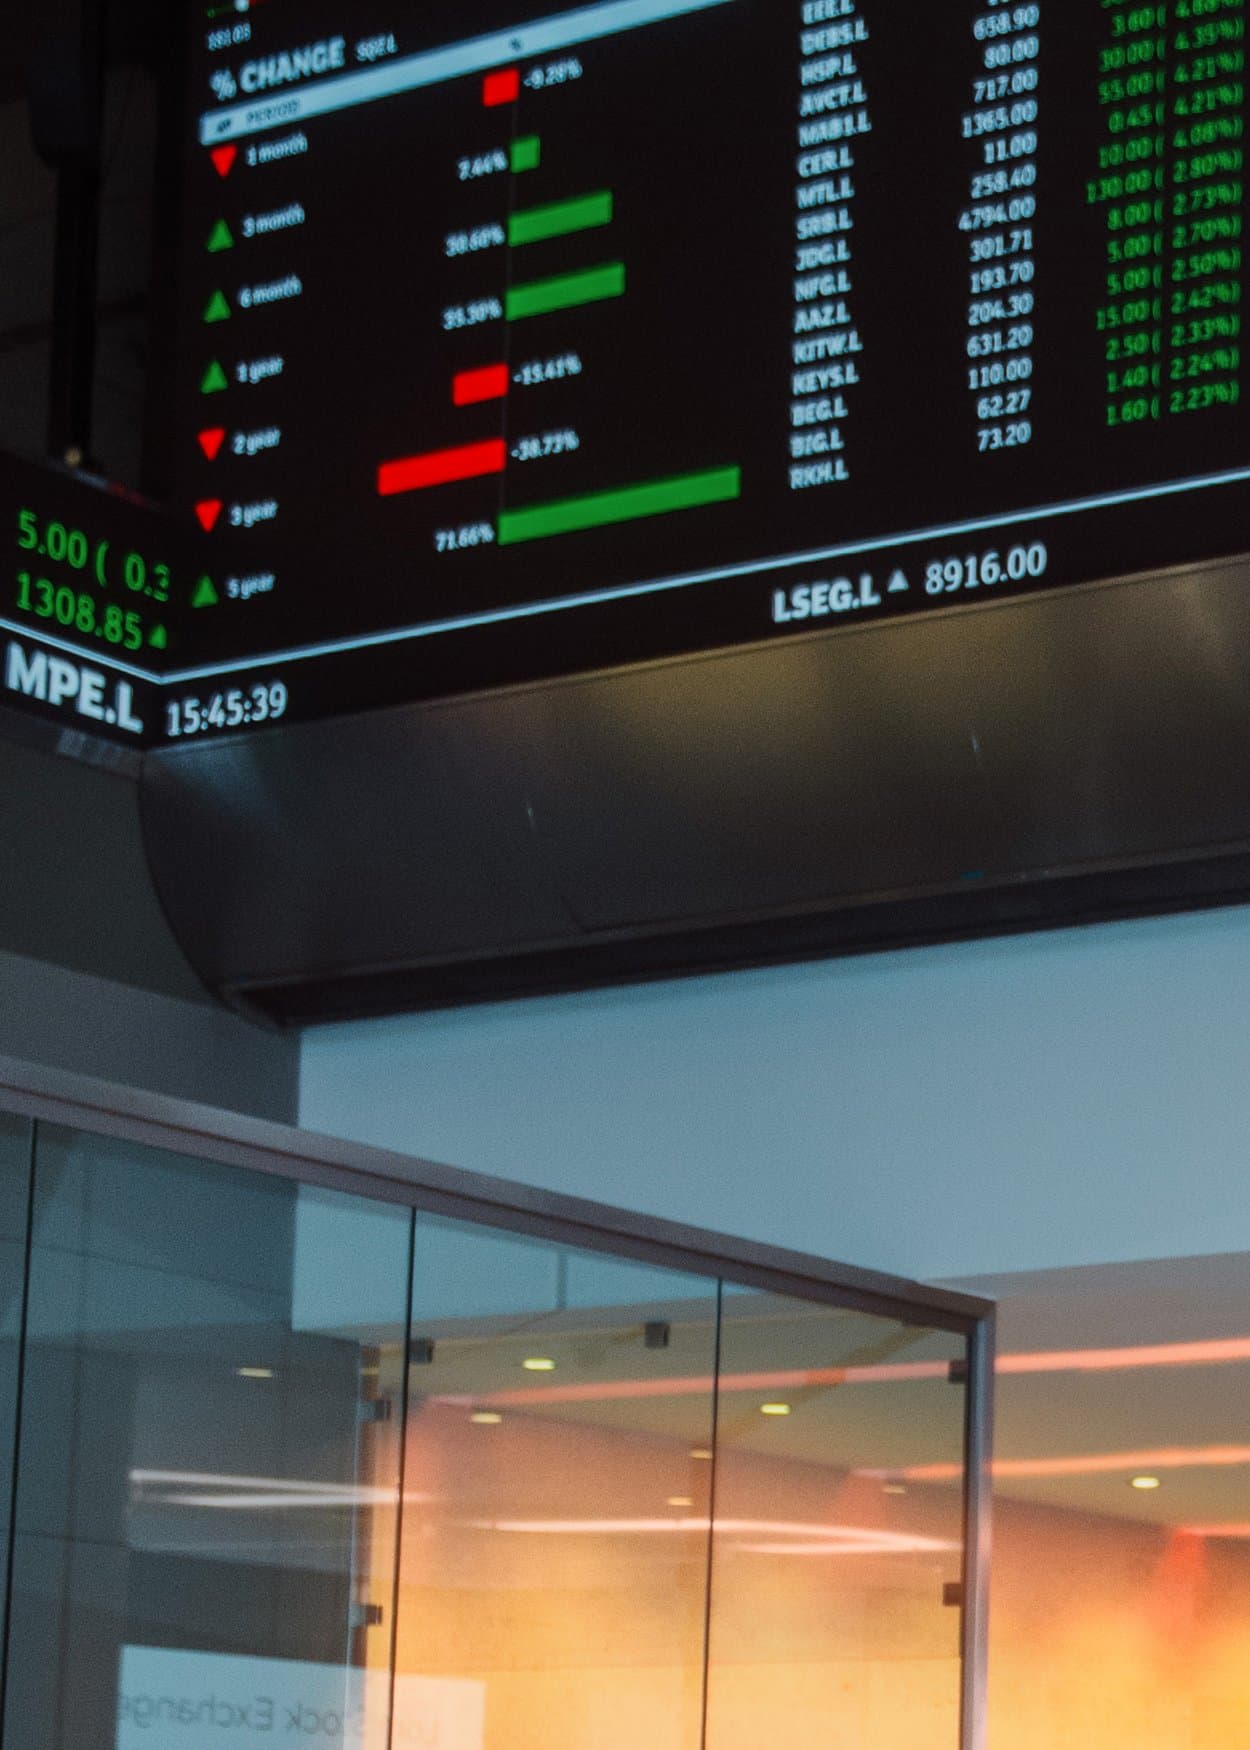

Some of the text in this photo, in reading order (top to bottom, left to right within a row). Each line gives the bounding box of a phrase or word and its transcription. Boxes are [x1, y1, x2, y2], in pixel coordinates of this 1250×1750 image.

[209, 68, 237, 101] %
[239, 36, 346, 93] CHANGE
[258, 132, 308, 163] month
[256, 203, 305, 234] month
[252, 275, 303, 306] month
[249, 357, 284, 385] year
[247, 426, 281, 456] year
[243, 501, 278, 528] year
[17, 508, 89, 570] 5.00
[241, 574, 276, 600] year
[773, 541, 1047, 623] LSEG.L 8916.00
[16, 570, 144, 652] 1308.85
[7, 641, 144, 735] MPE.L
[167, 681, 288, 738] 15:45:39
